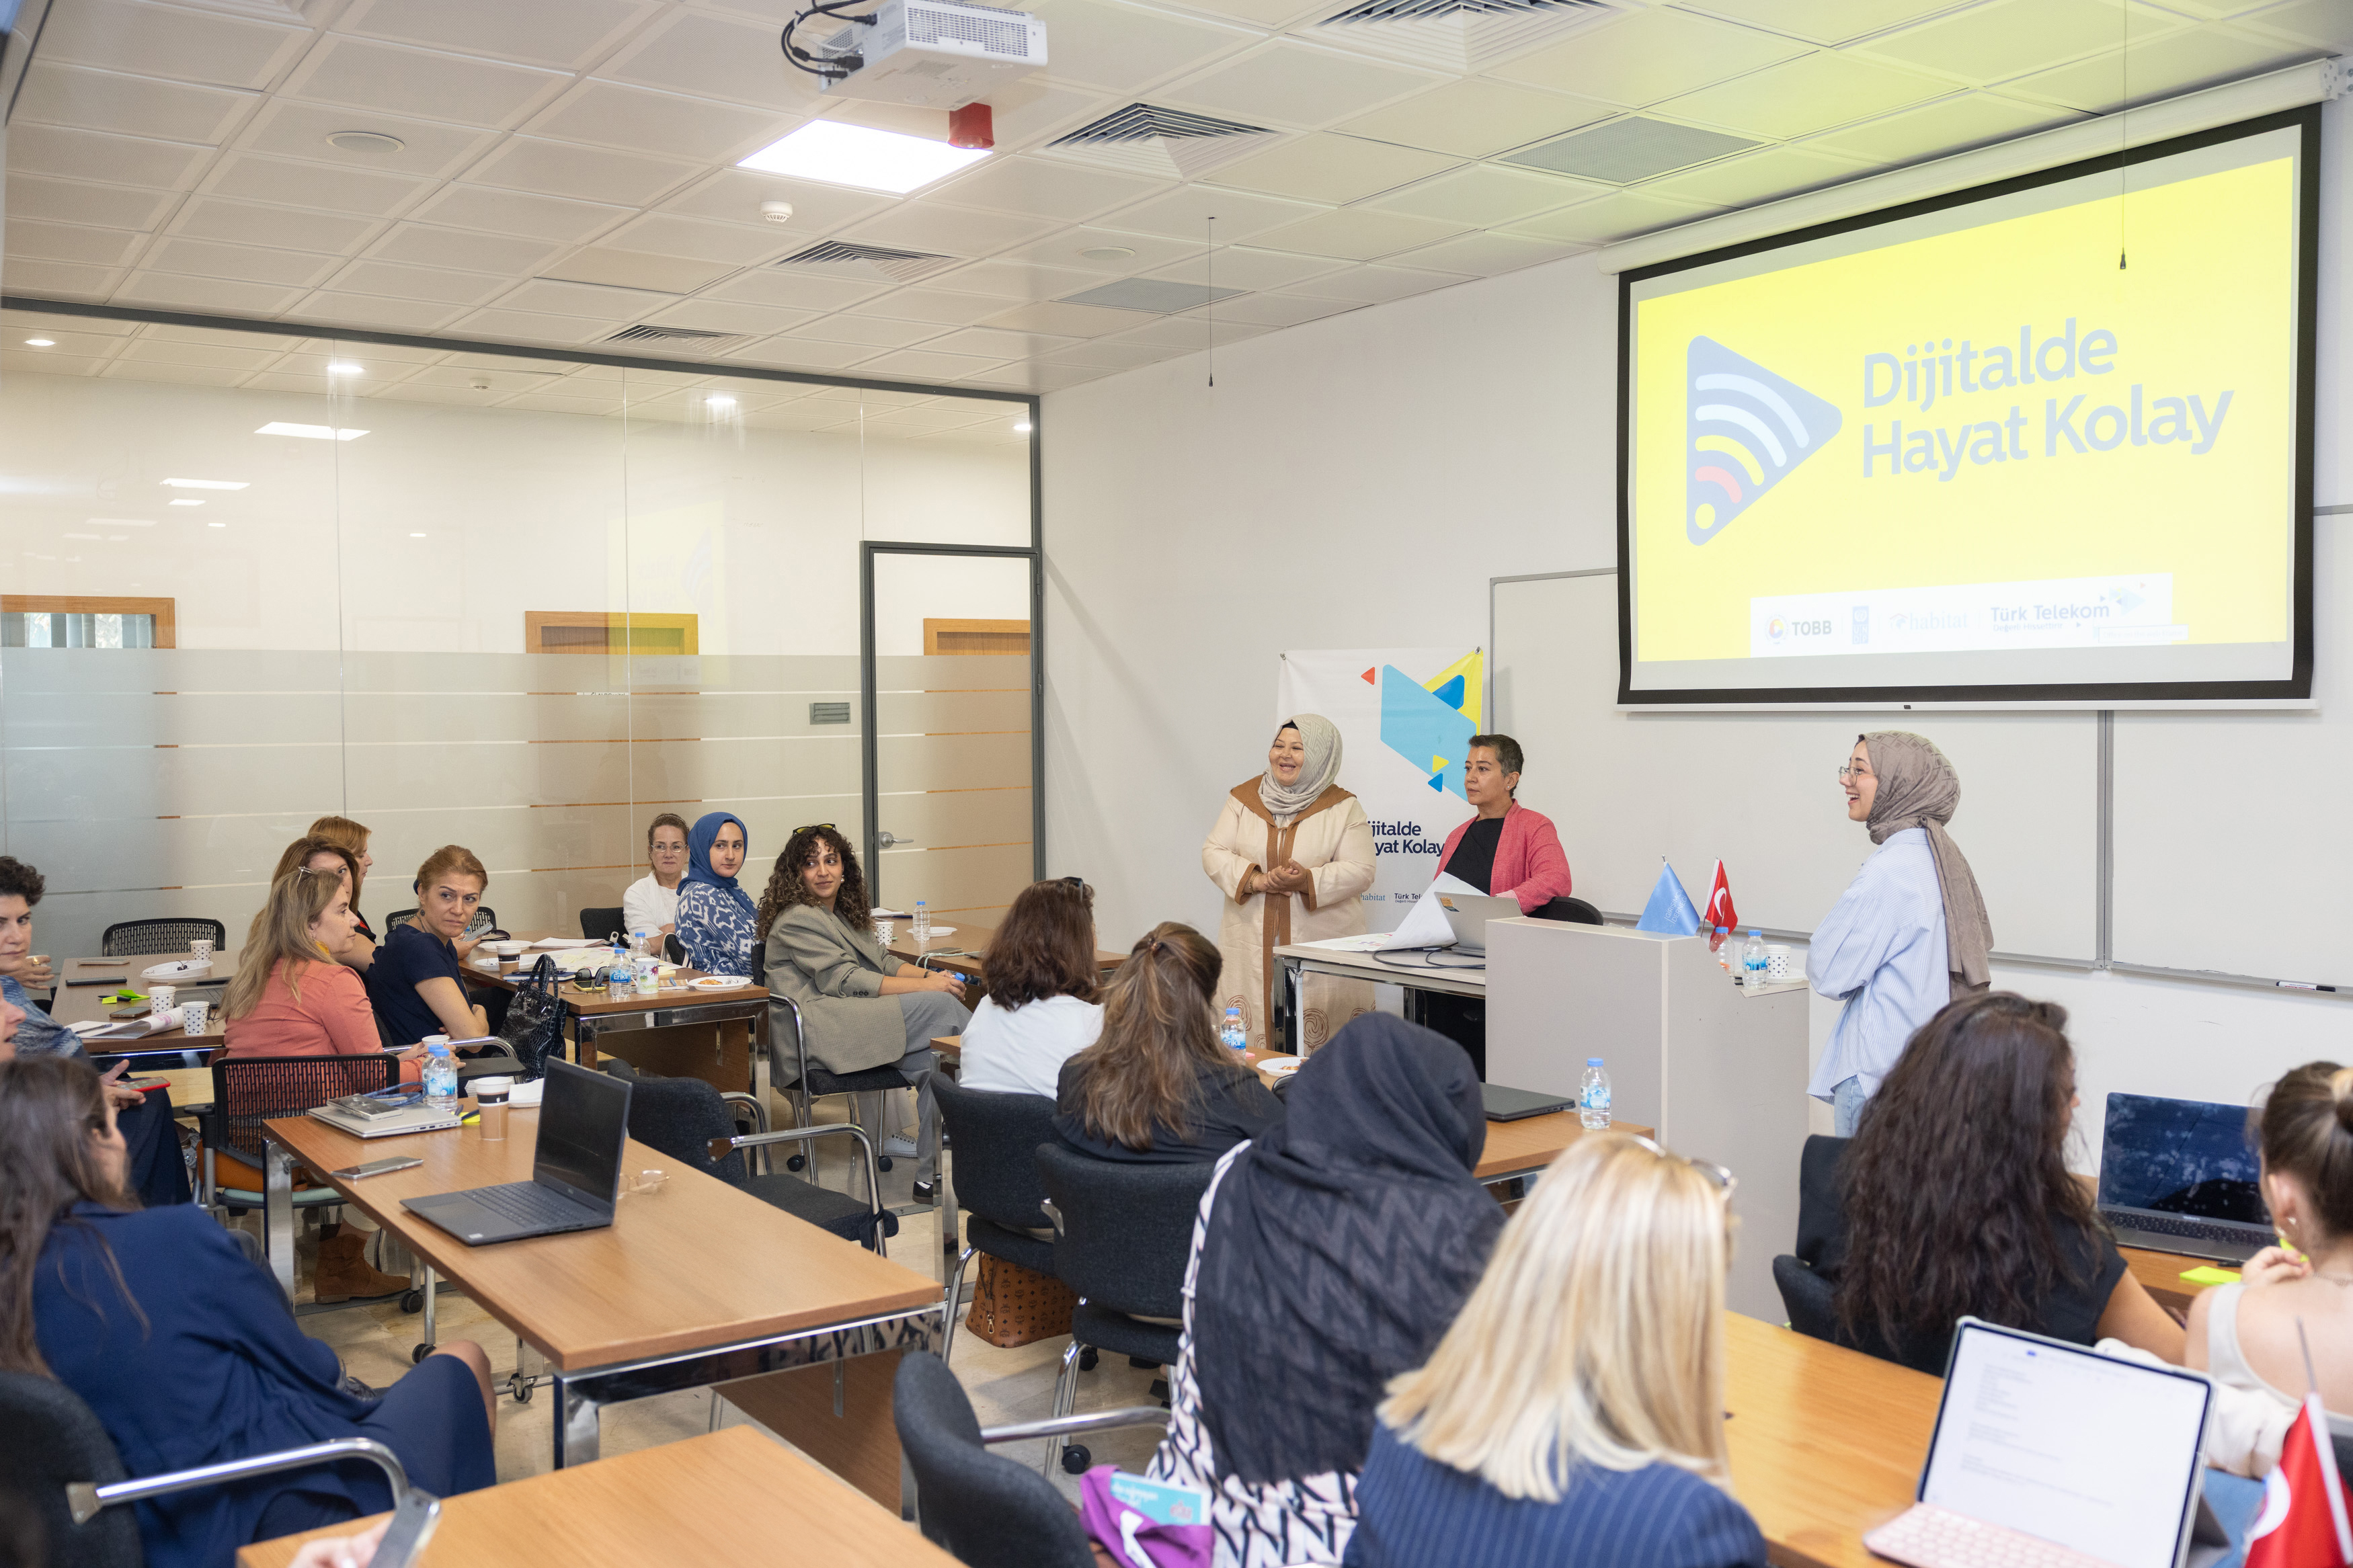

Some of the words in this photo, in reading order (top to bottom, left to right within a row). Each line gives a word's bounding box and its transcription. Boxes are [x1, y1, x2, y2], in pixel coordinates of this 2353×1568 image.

[1864, 317, 2118, 413] Dijitalde
[1863, 405, 2029, 483] Hayat
[2045, 383, 2235, 455] Kolay
[1909, 610, 1968, 630] habitat
[1991, 607, 2028, 622] Türk
[2034, 603, 2110, 620] Telekom
[1791, 620, 1832, 636] TOBB
[1993, 624, 2020, 633] Değerli
[1367, 821, 1422, 837] jitalde
[1374, 839, 1399, 856] yat
[1402, 839, 1445, 857] Kolay
